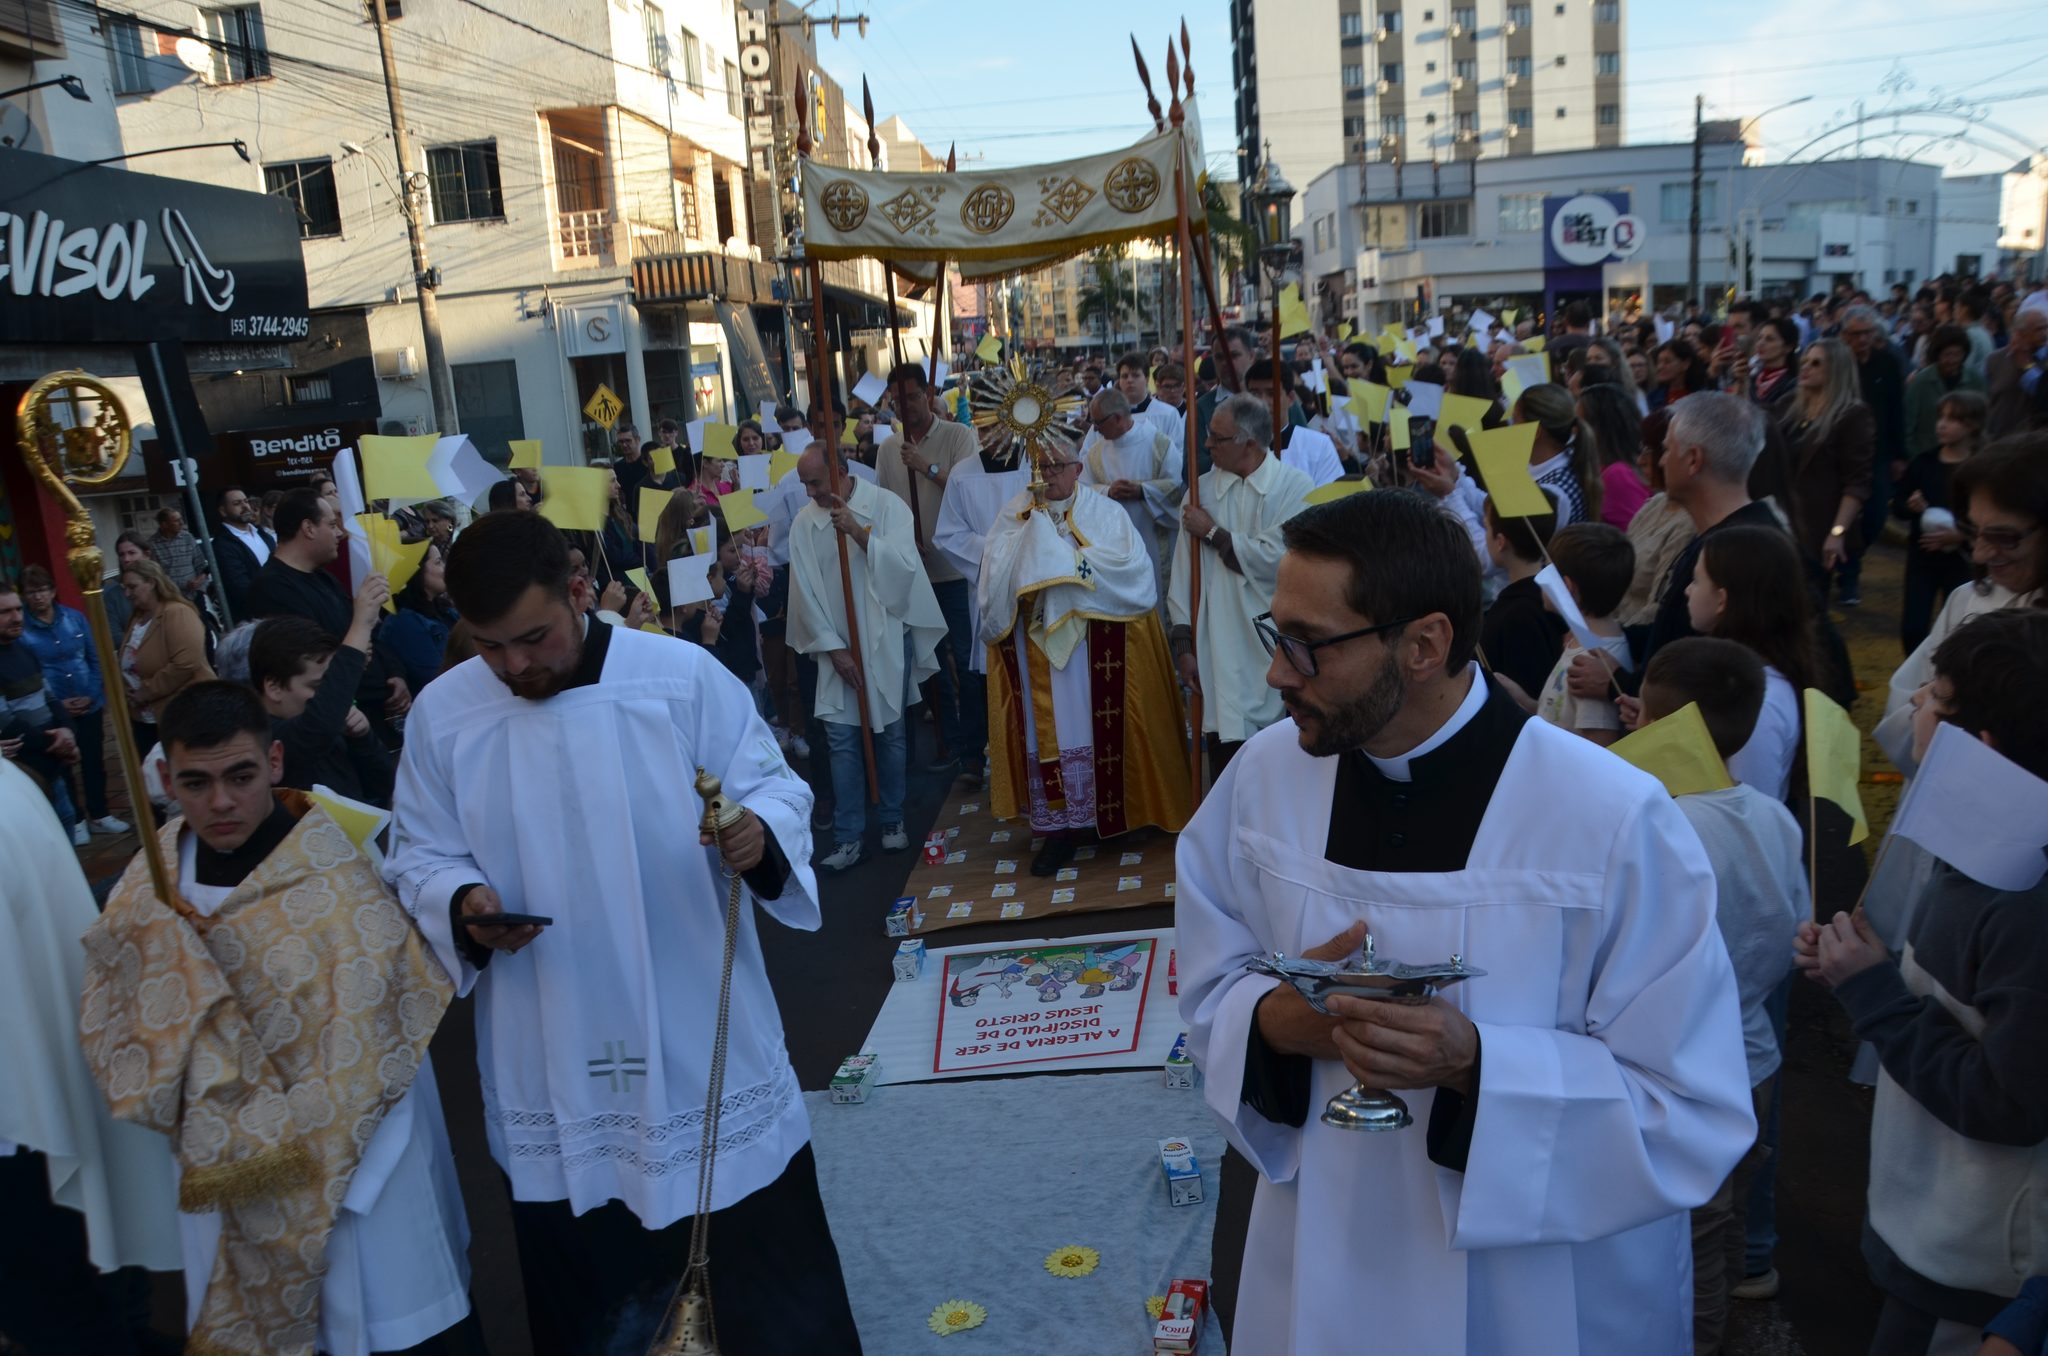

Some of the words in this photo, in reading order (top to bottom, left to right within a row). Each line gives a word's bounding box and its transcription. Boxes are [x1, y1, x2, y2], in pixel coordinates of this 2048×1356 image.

[737, 8, 775, 182] HOTEL
[249, 315, 309, 337] 3744-2945
[250, 428, 341, 457] Bendito
[975, 1012, 1041, 1028] CRISTO
[1045, 1004, 1104, 1020] JESUS
[1004, 1017, 1101, 1036] DISCÍPULO
[1107, 1028, 1121, 1038] A
[975, 1030, 1001, 1041] DE
[1026, 1030, 1103, 1048] ALEGRIA
[955, 1045, 991, 1057] SER
[996, 1040, 1020, 1052] DE
[1161, 1324, 1191, 1334] TIROL
